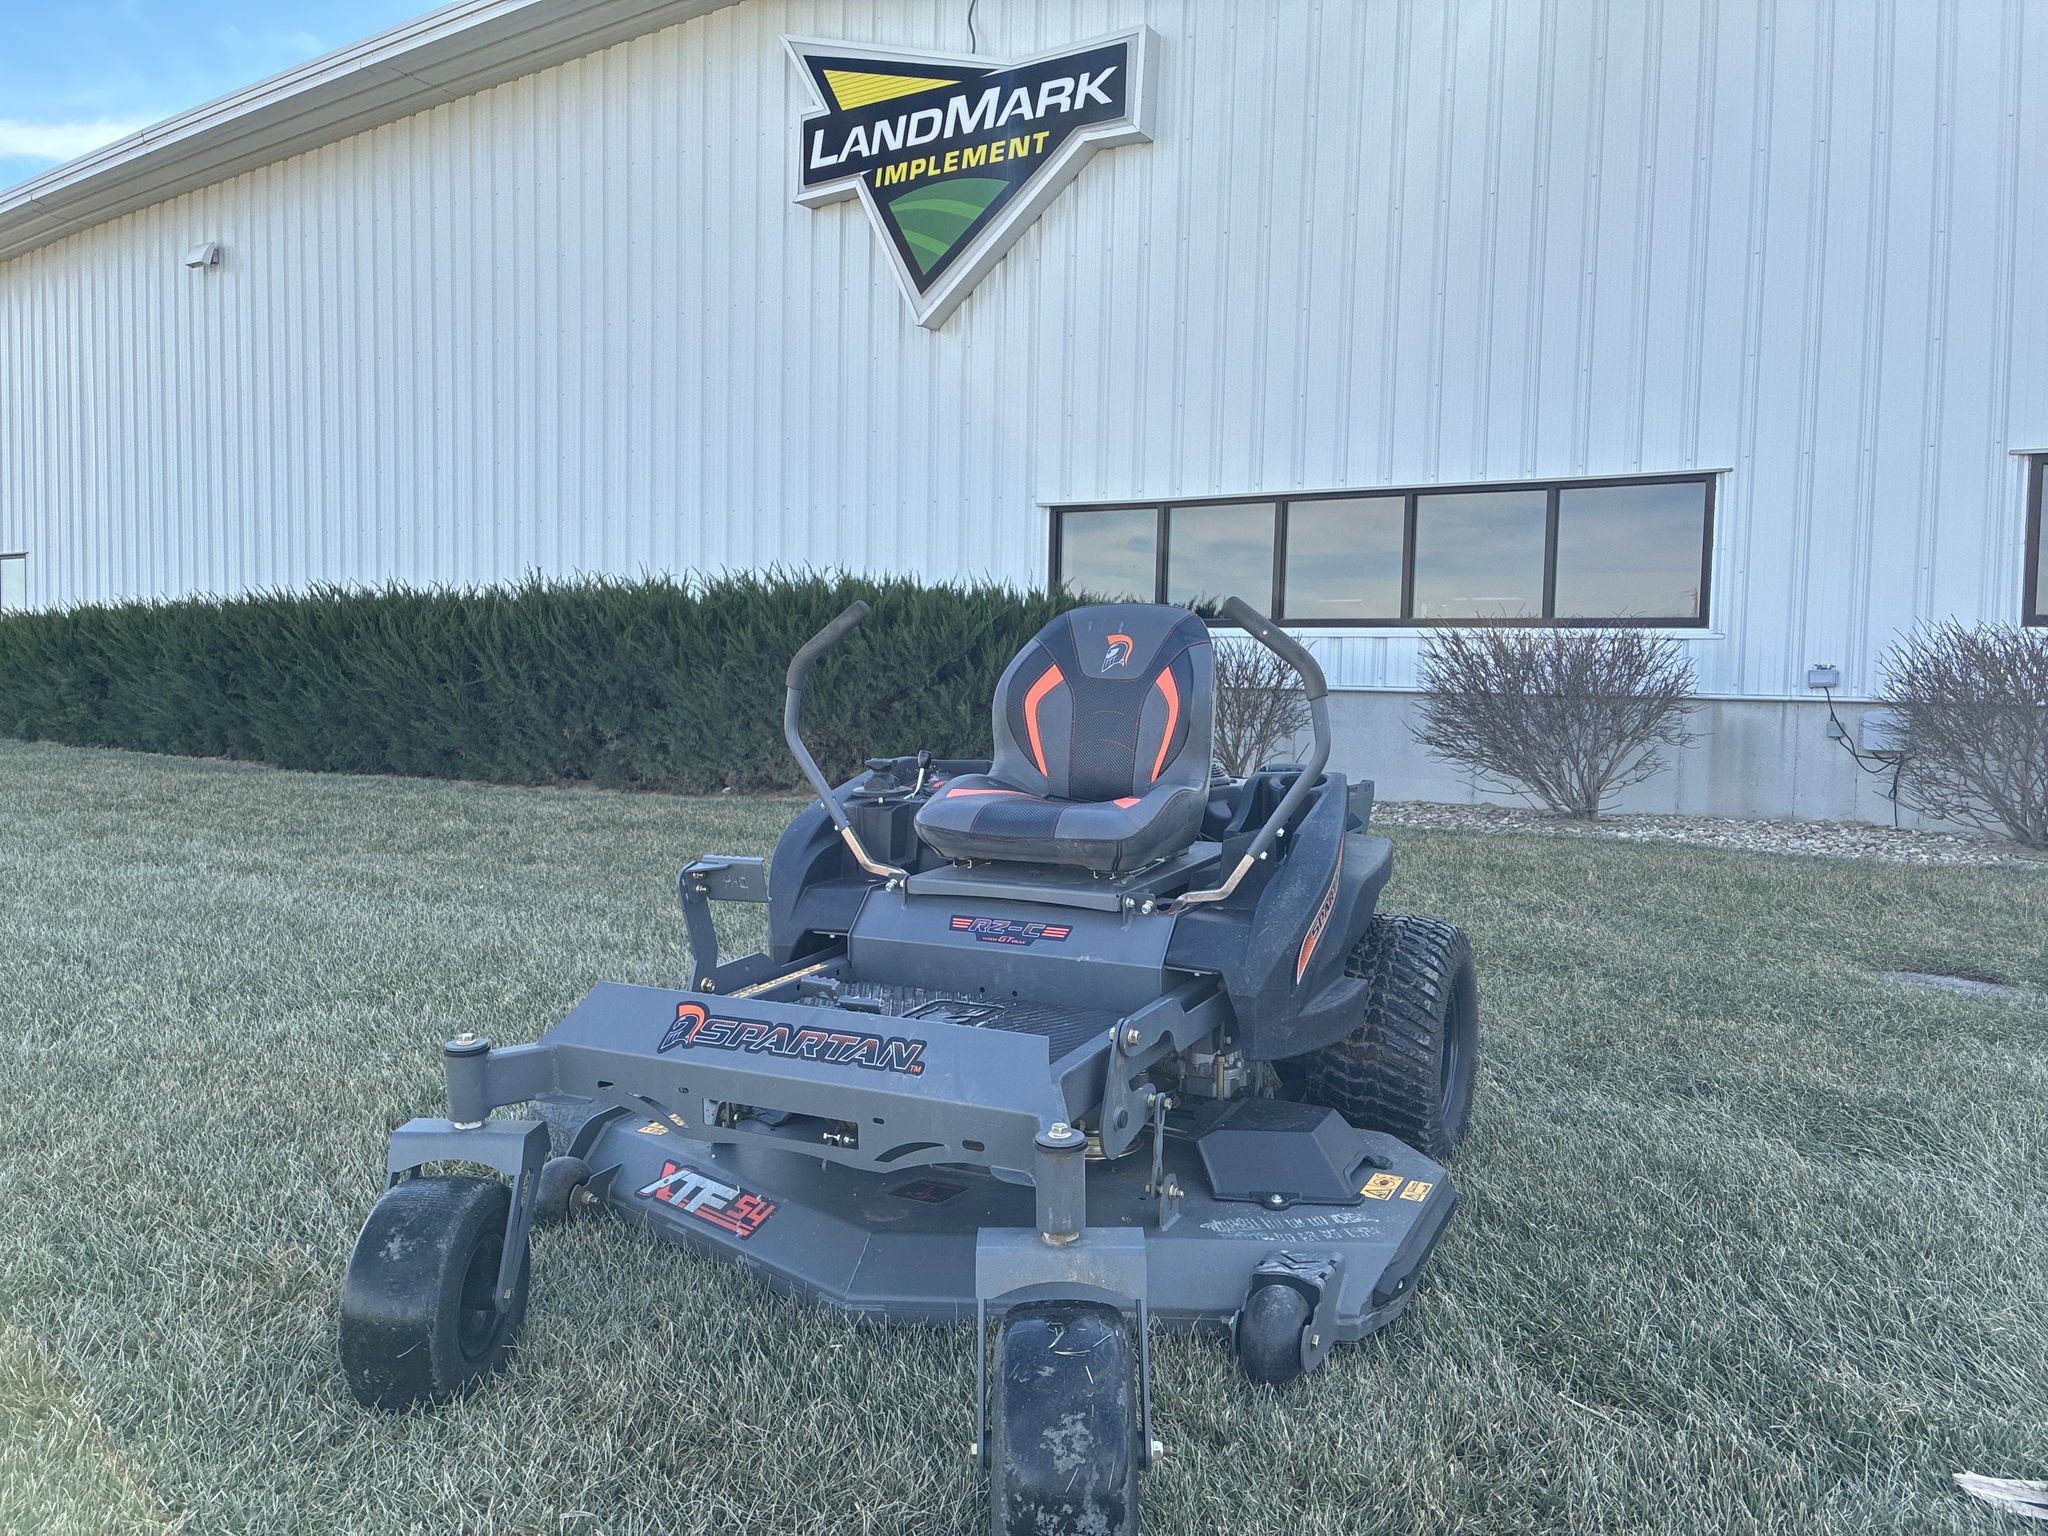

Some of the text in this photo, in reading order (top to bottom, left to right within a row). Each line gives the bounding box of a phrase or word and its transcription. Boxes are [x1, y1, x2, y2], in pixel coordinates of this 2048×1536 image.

[809, 65, 1119, 170] LANDMARK
[874, 131, 1050, 188] IMPLEMENT
[968, 917, 1046, 938] RZ-C
[692, 1018, 924, 1071] SPARTAN
[638, 1161, 777, 1228] XTF 54
